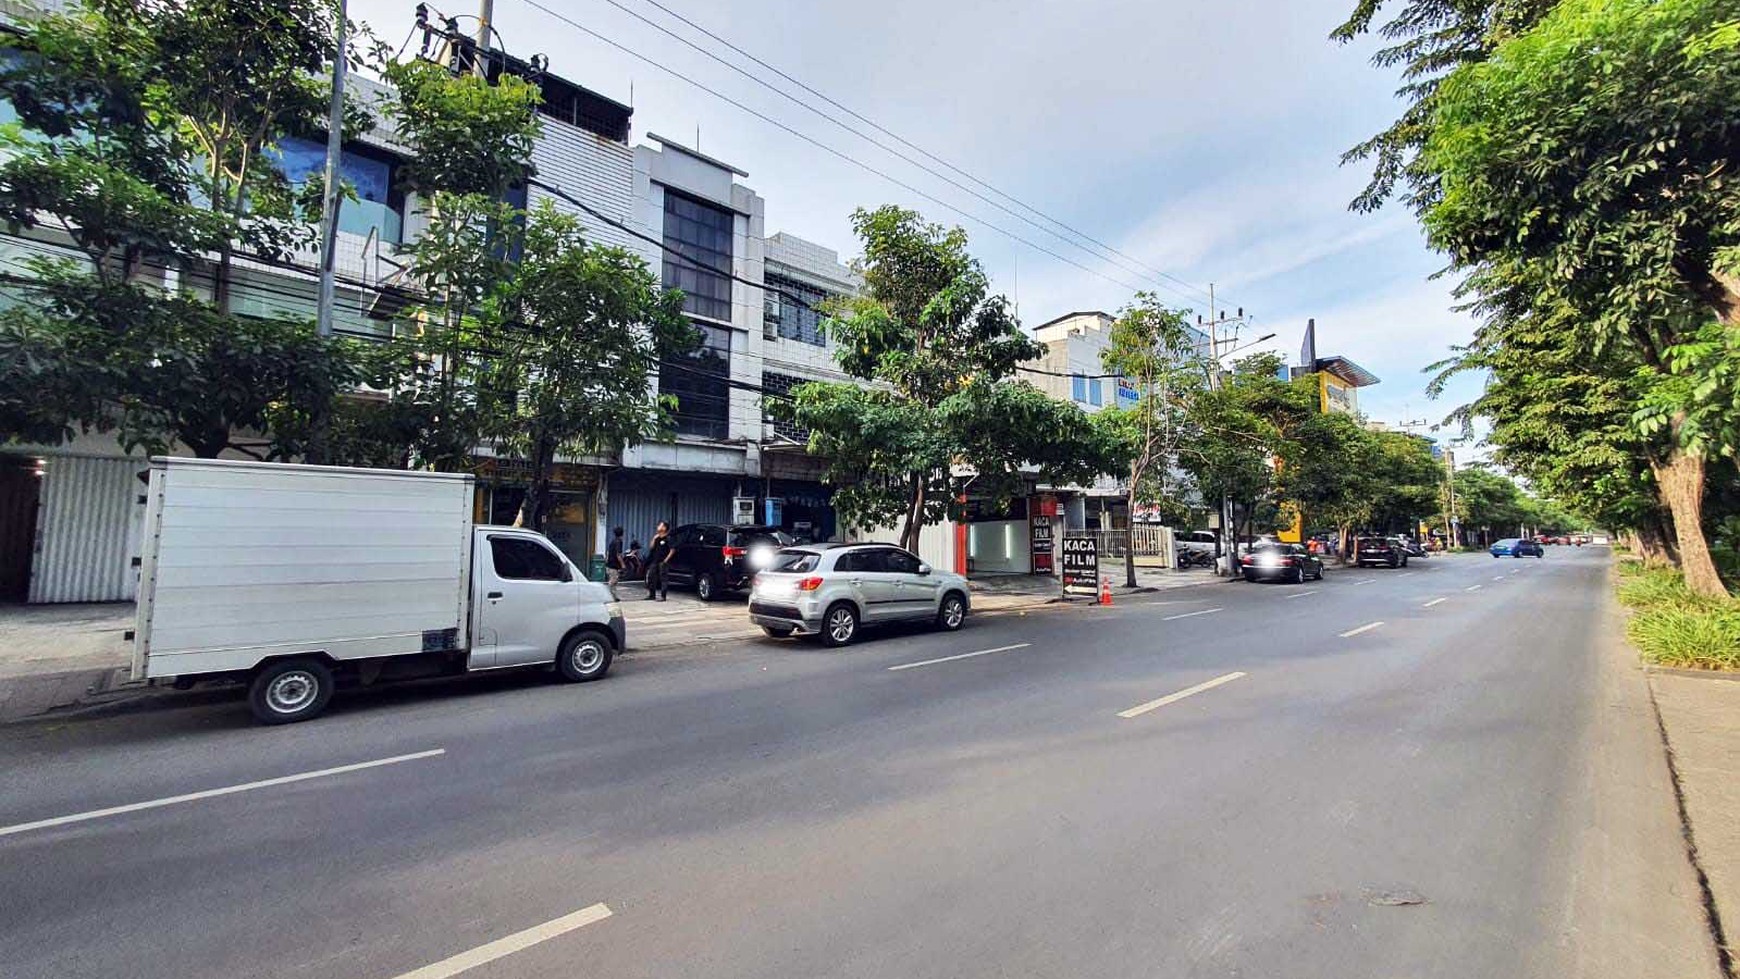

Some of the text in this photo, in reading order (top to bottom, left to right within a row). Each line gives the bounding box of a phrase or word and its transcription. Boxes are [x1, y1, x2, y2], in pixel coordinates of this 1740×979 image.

[1034, 517, 1050, 526] KACA
[1034, 528, 1049, 538] FILM
[1064, 540, 1095, 551] KACA
[1064, 554, 1095, 566] FILM
